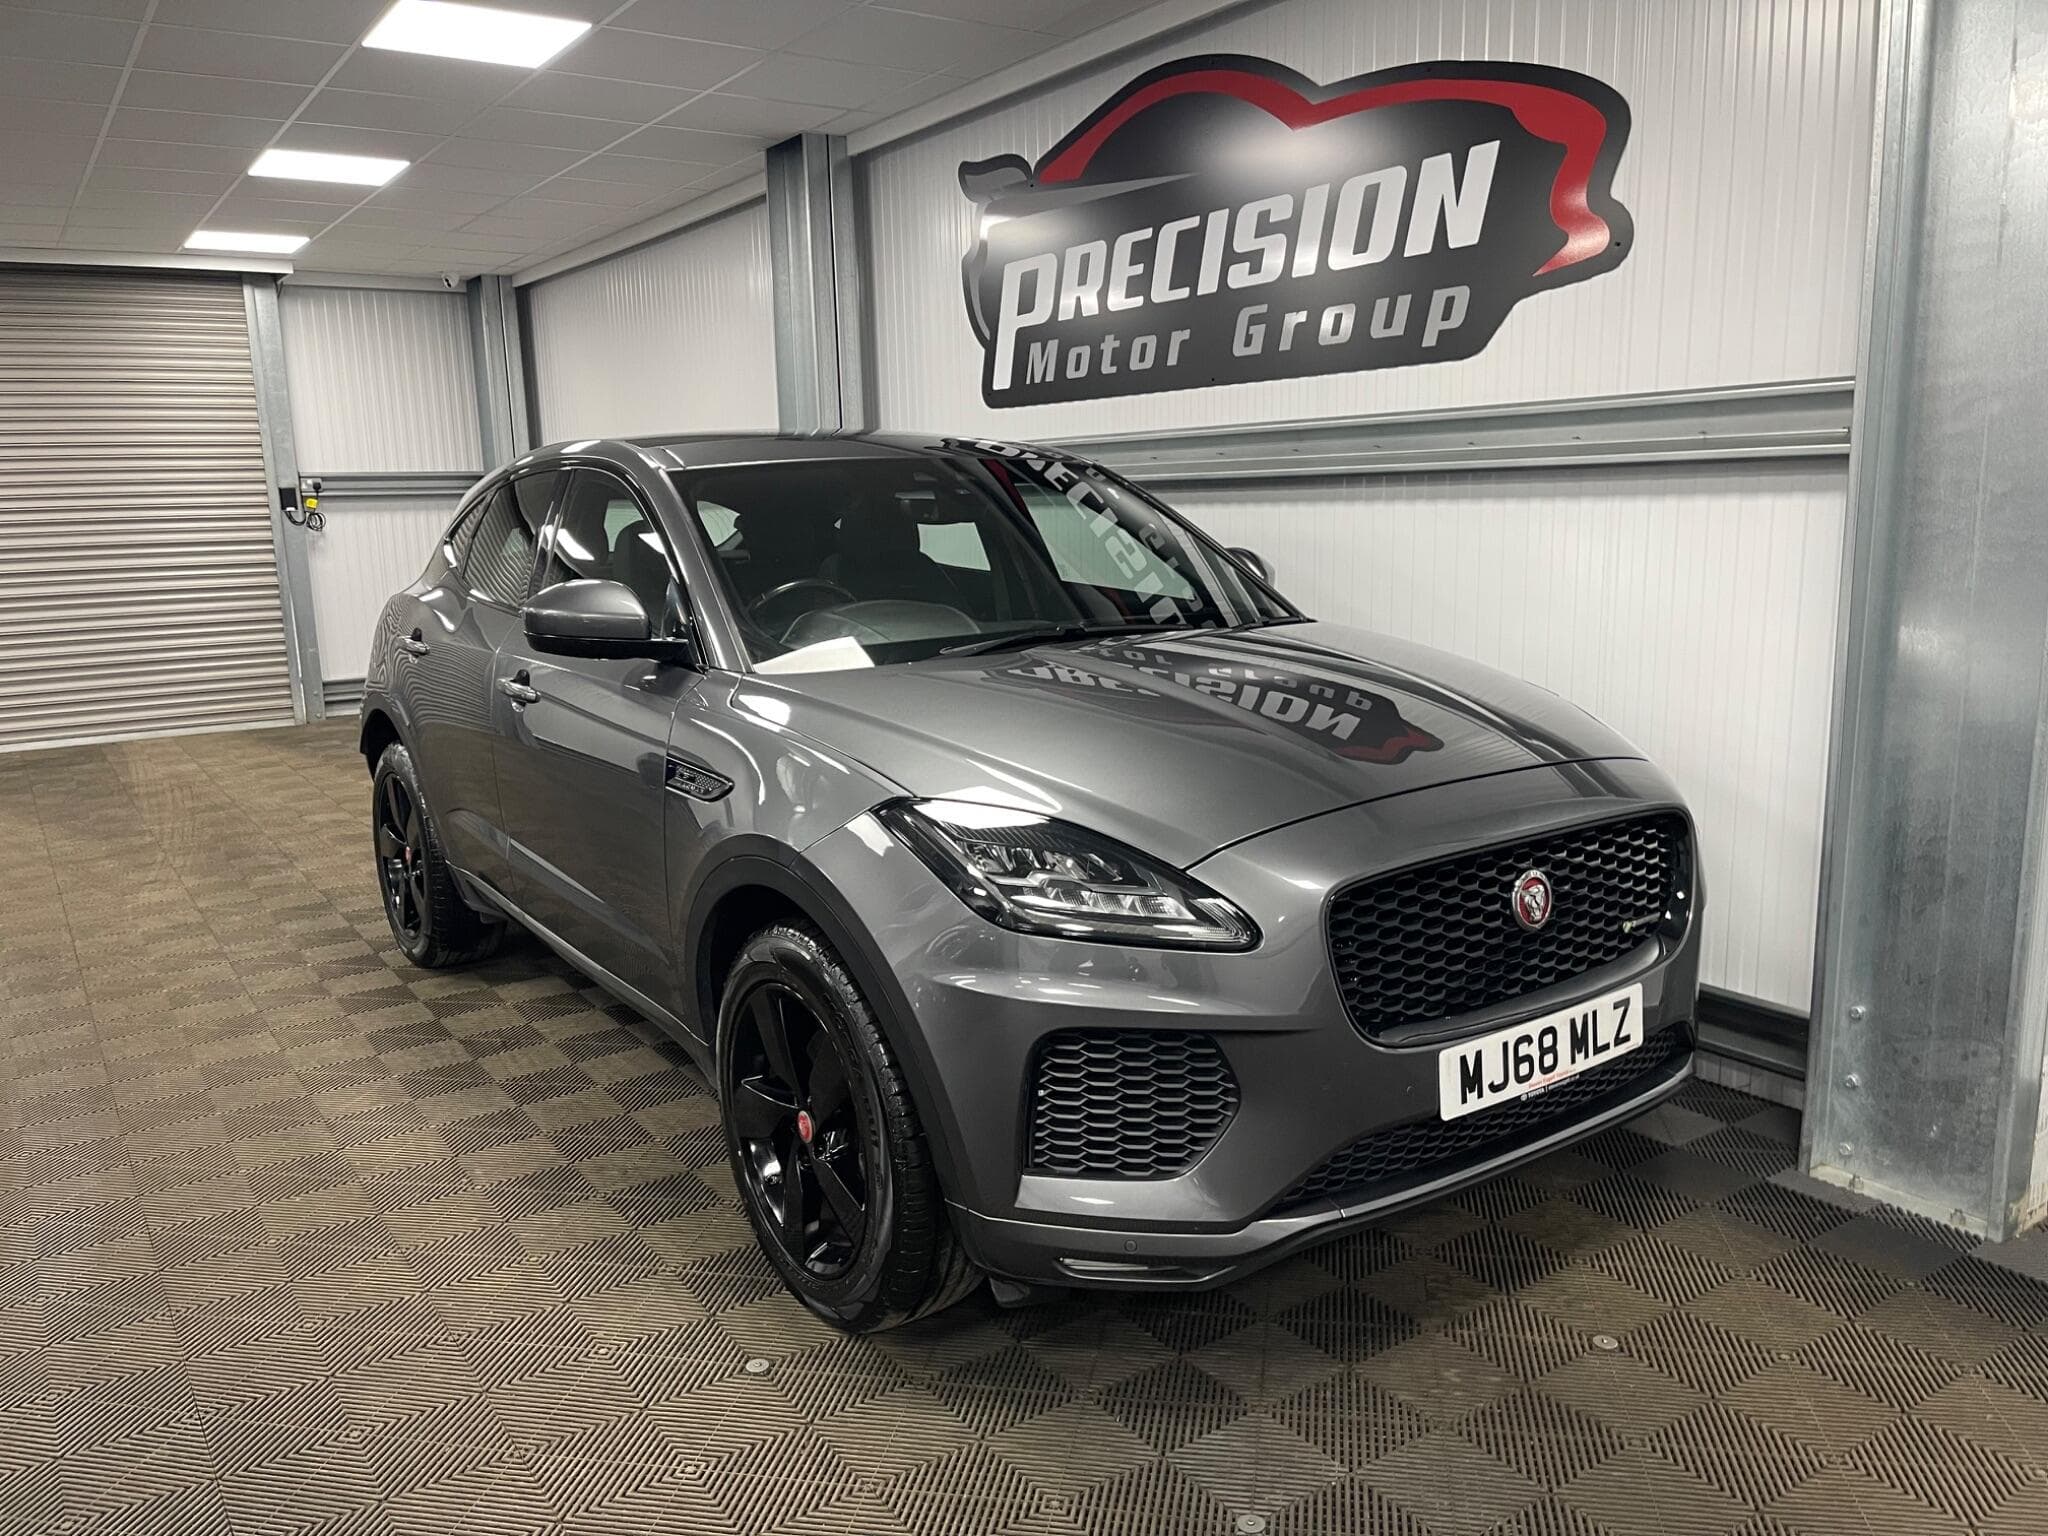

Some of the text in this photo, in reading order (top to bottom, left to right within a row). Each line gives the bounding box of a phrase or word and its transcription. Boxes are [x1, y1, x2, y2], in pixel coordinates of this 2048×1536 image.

[992, 140, 1501, 390] PRECISION
[1025, 285, 1471, 385] Motor Group
[1459, 997, 1632, 1105] MJ68 MLZ
